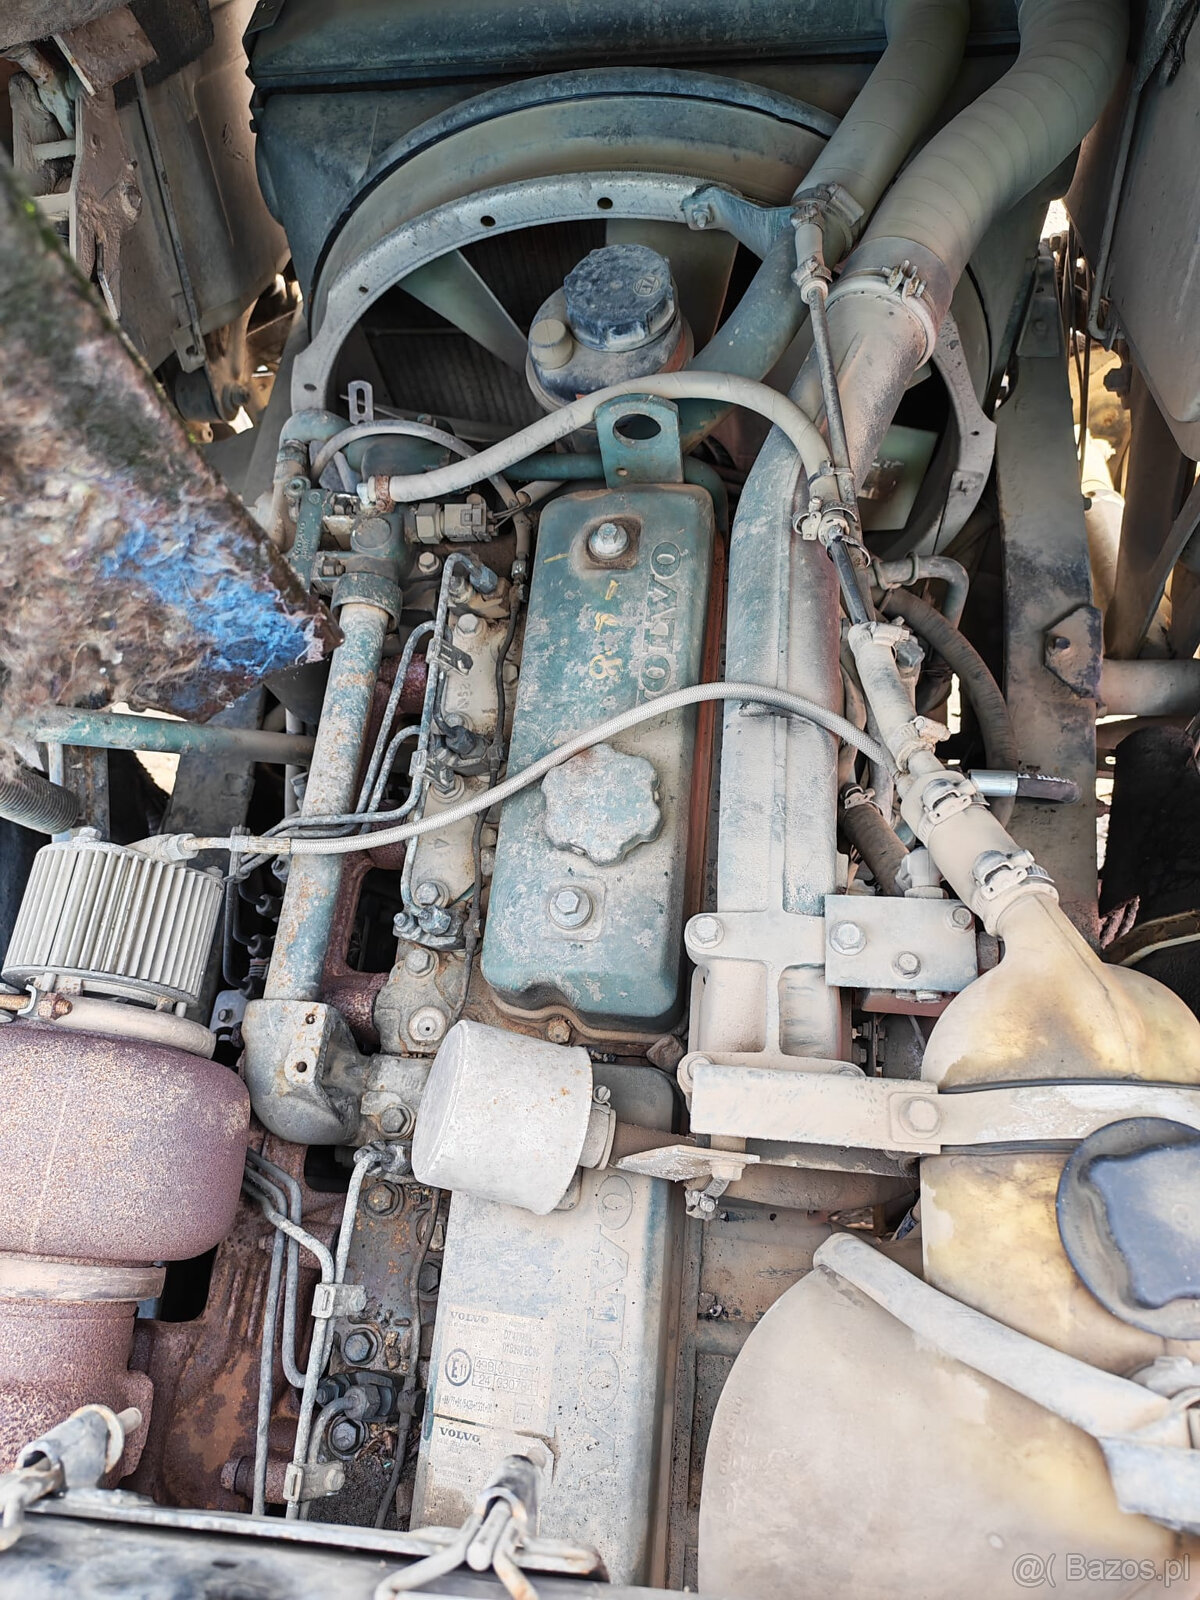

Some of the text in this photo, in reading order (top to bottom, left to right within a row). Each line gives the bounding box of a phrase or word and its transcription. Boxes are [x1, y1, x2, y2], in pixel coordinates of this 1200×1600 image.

[451, 1311, 490, 1324] VOLVO
[478, 1374, 491, 1386] 24
[440, 1426, 481, 1443] VOLVO
